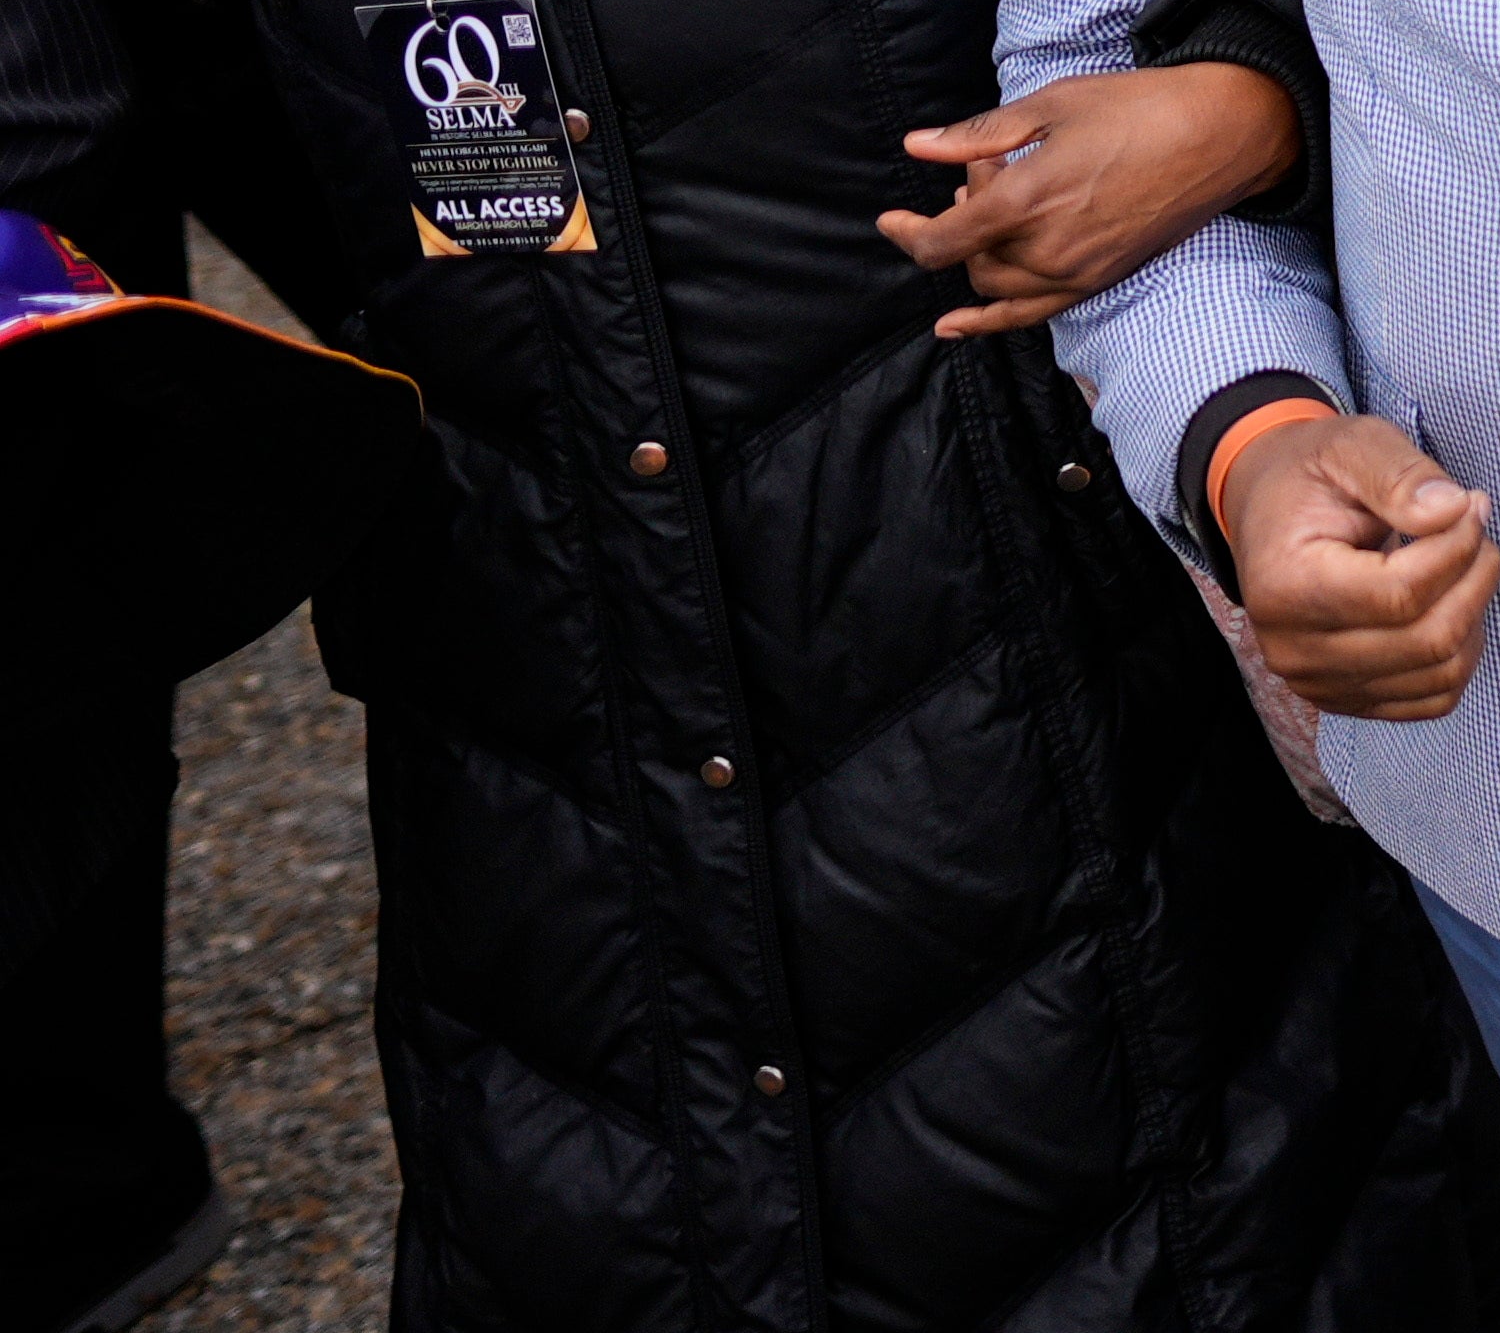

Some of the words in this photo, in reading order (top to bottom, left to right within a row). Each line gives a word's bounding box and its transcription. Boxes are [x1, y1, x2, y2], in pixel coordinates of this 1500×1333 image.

[404, 15, 500, 107] 60
[425, 105, 517, 130] SELMA
[420, 147, 450, 157] NEVER
[488, 145, 518, 156] NEVER
[520, 143, 548, 153] AGAIN
[411, 160, 456, 173] NEVER
[456, 158, 491, 172] STOP
[492, 155, 559, 171] FIGHTING
[436, 199, 475, 221] ALL
[480, 196, 565, 220] ACCESS
[454, 221, 484, 232] MARCH
[492, 220, 521, 230] MARCH
